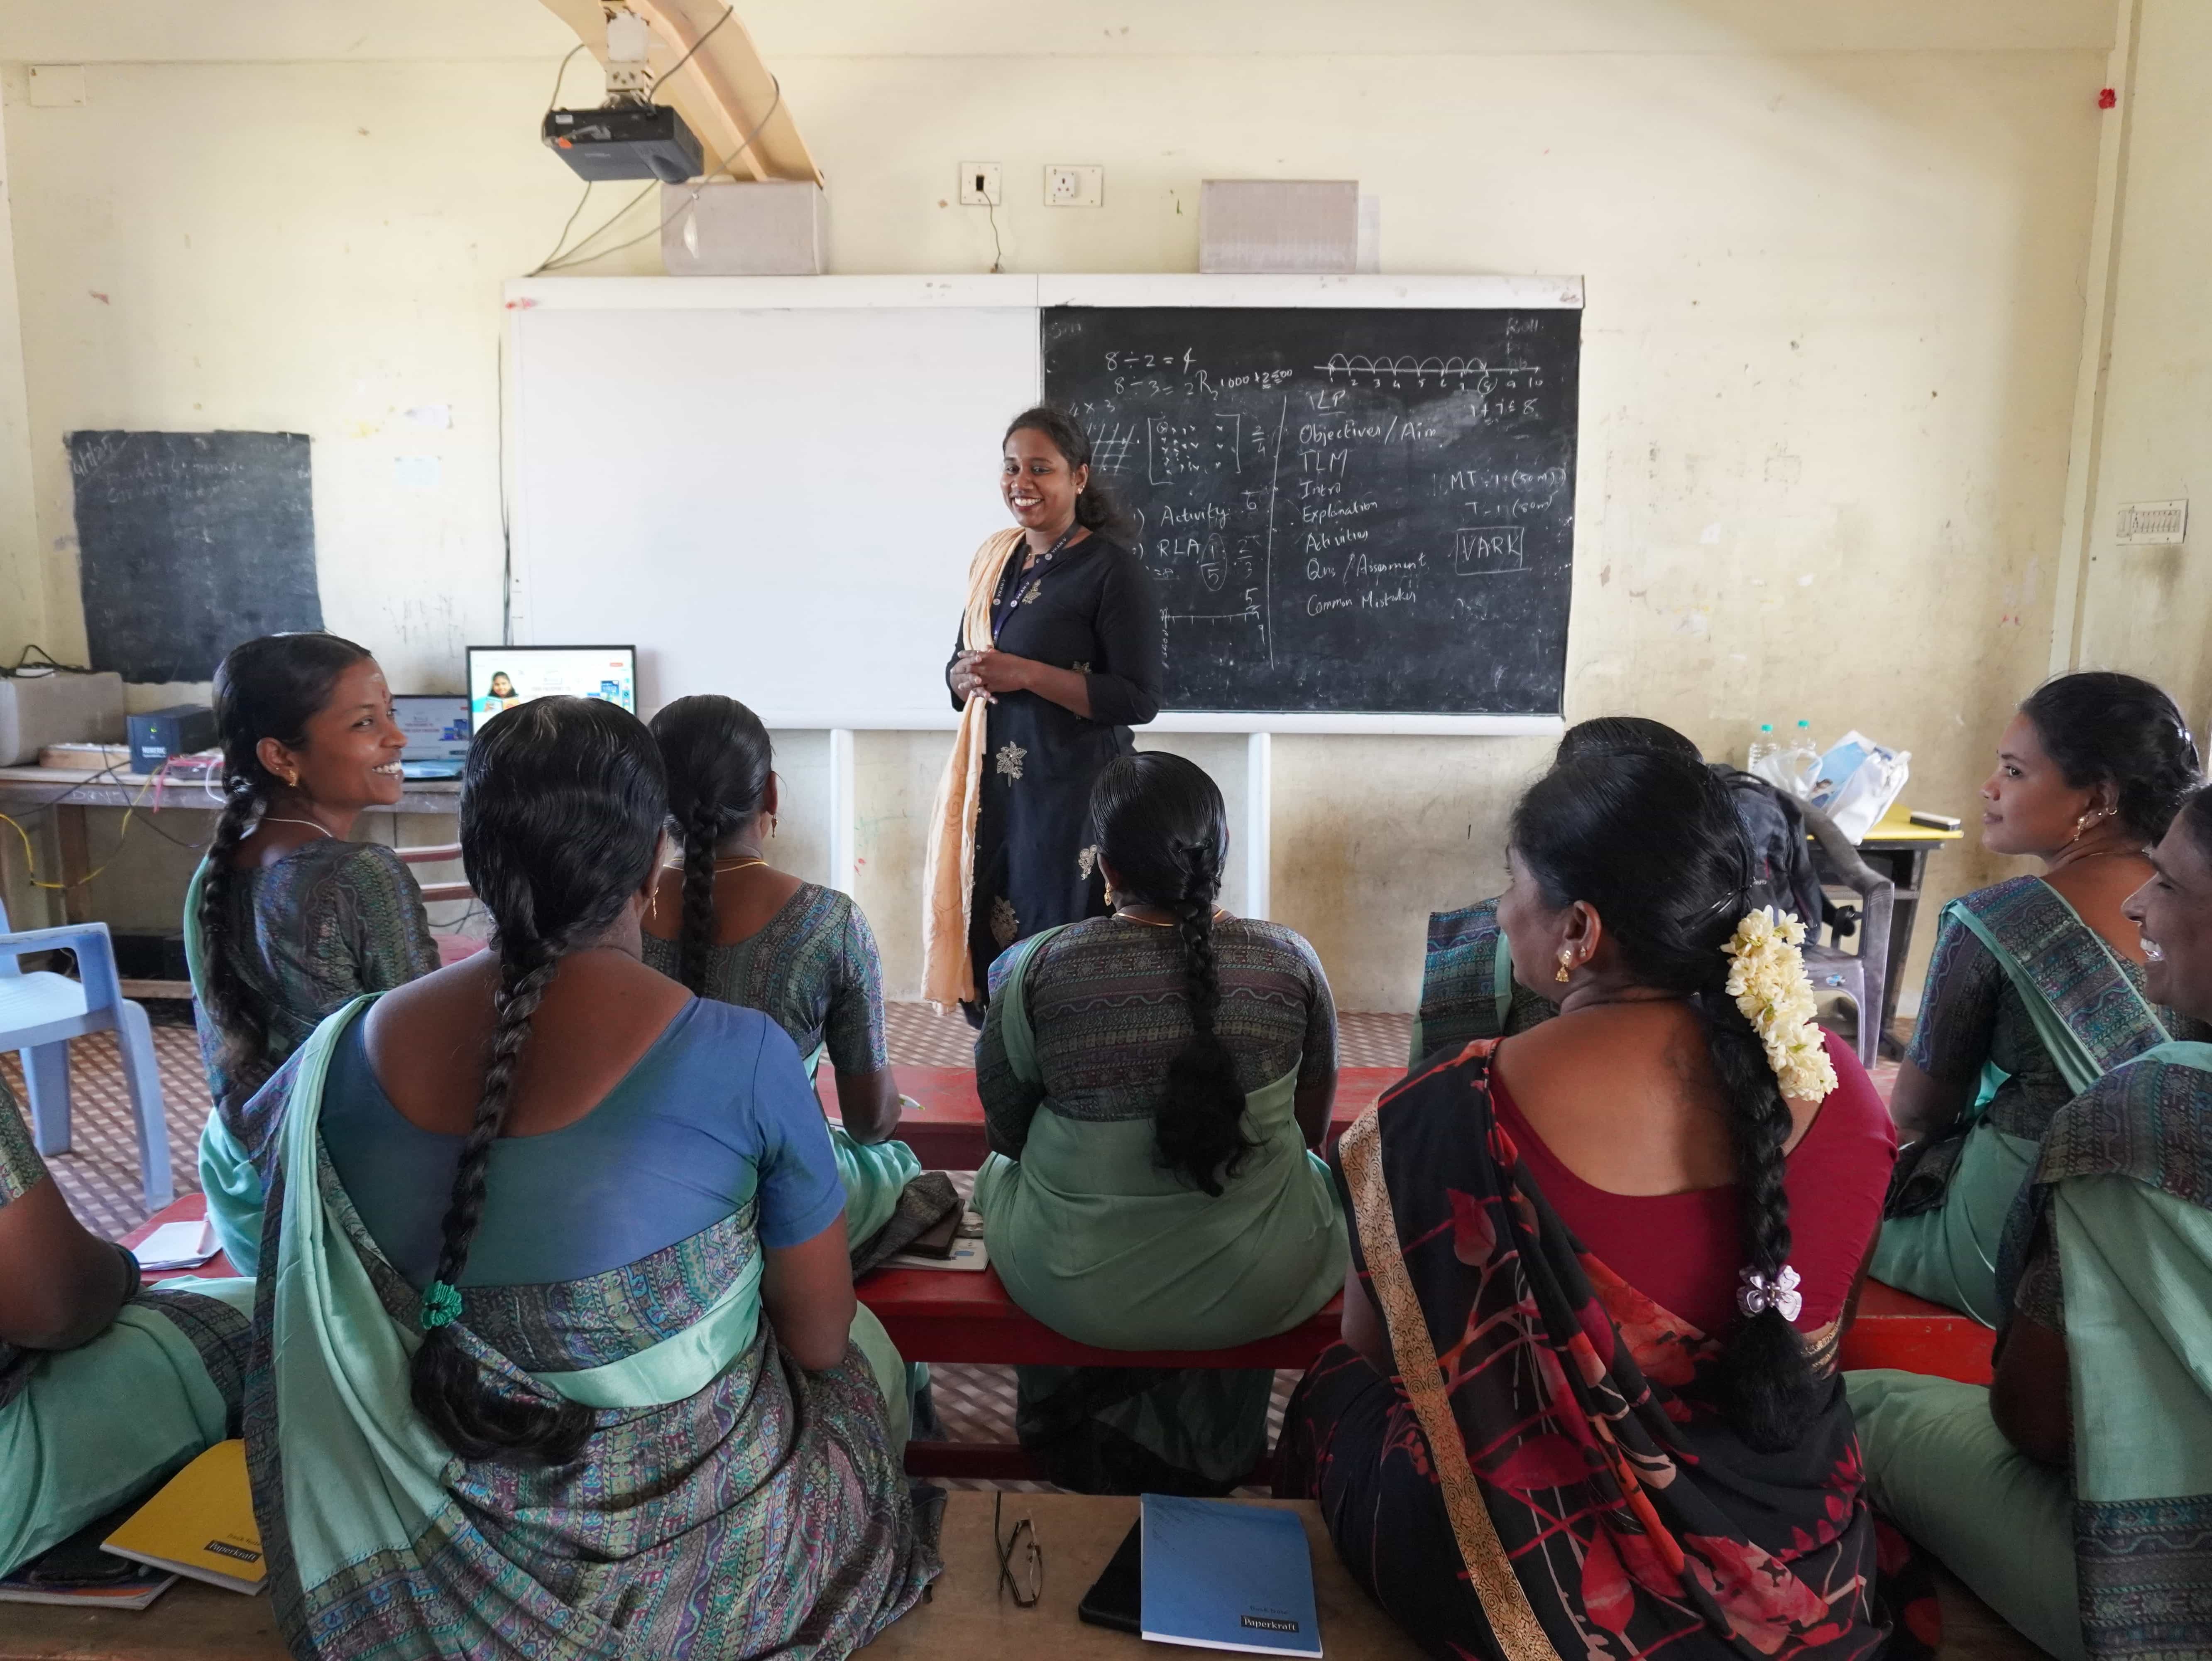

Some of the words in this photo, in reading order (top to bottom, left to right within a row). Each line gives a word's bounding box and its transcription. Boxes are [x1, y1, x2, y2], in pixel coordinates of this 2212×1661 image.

[1106, 351, 1120, 371] 8
[1145, 355, 1156, 367] 2
[1114, 376, 1125, 394] 8
[1149, 381, 1161, 397] 3
[1184, 383, 1194, 395] 2
[1221, 374, 1249, 389] 1000
[1374, 379, 1381, 388] 3
[1392, 380, 1400, 389] 4
[1507, 380, 1516, 388] 9
[1529, 377, 1544, 388] 10
[1104, 399, 1115, 412] 3
[1523, 398, 1538, 414] 8
[1299, 448, 1348, 479] TLM
[1299, 480, 1341, 500] Intro
[1451, 470, 1477, 490] MT
[1247, 494, 1257, 510] 6
[1303, 500, 1378, 524] Explanation
[1161, 502, 1230, 529] Activity
[1156, 539, 1201, 558] RLA
[1463, 534, 1521, 561] VARK
[1237, 539, 1251, 554] 2
[1245, 562, 1253, 579] 3
[1208, 568, 1220, 585] 5
[1246, 588, 1259, 606] 5
[1307, 594, 1352, 617] Common
[209, 1541, 257, 1561] Paperkraft
[1243, 1617, 1296, 1631] Paperkraft
